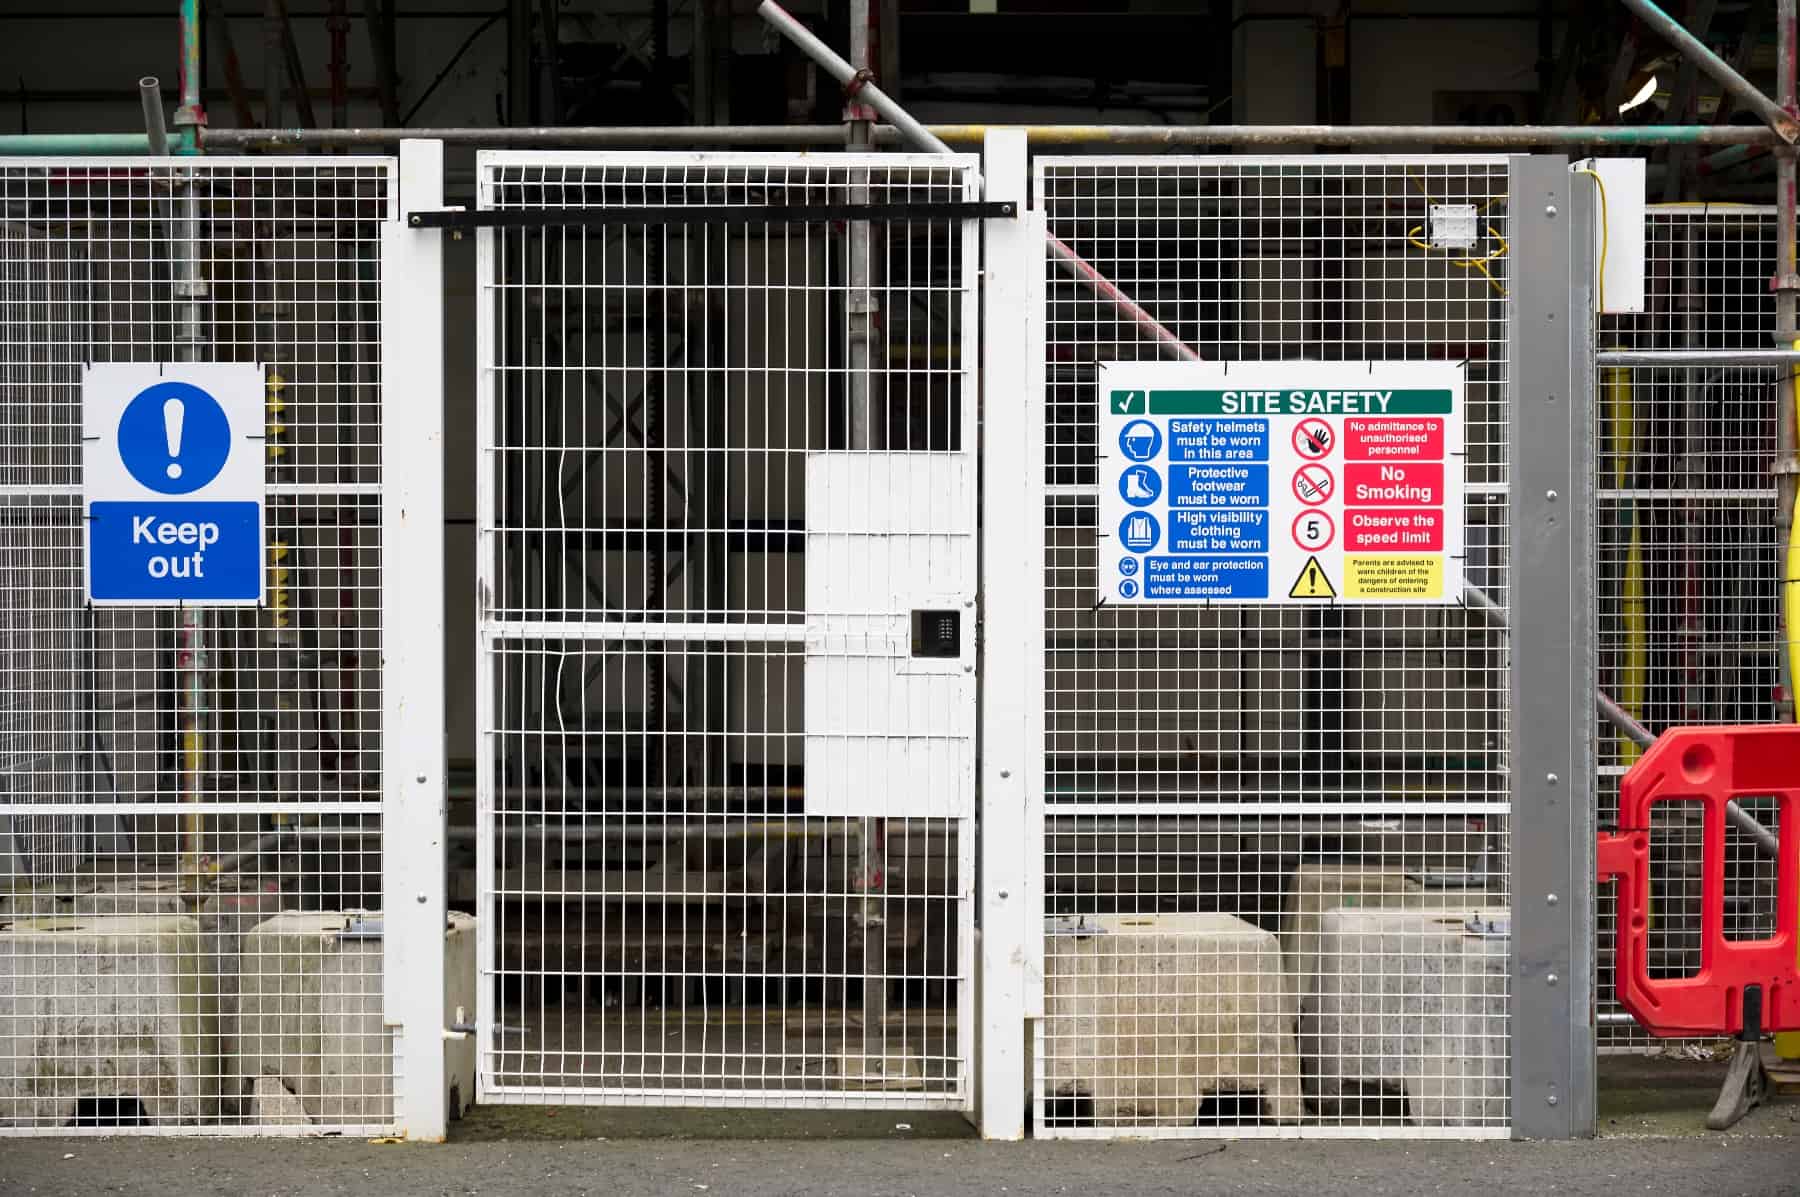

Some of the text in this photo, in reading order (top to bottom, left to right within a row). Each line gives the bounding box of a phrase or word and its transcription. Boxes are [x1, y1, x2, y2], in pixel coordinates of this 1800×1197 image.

[1222, 392, 1392, 413] SITE SAFETY
[1172, 422, 1264, 435] Safety helmets
[1351, 422, 1437, 431] No admittance to
[1177, 437, 1207, 445] must
[1211, 435, 1226, 445] be
[1360, 434, 1427, 443] unauthorised
[1184, 449, 1196, 458] in
[1199, 448, 1222, 458] this
[1368, 446, 1419, 456] personnel
[1189, 467, 1248, 478] Protective
[1381, 466, 1405, 480] No
[1192, 481, 1245, 491] footwear
[1356, 484, 1431, 501] Smoking
[1178, 494, 1259, 504] must be worn
[1178, 512, 1262, 523] High visibility
[1352, 516, 1434, 527] Observe the
[133, 515, 219, 551] Keep
[1191, 526, 1240, 537] clothing
[1307, 520, 1319, 539] 5
[1177, 540, 1207, 549] must
[1211, 538, 1226, 549] be
[1357, 532, 1430, 546] speed limit
[148, 552, 204, 577] out
[1150, 561, 1168, 571] Eye
[1172, 561, 1190, 569] and
[1212, 561, 1263, 571] protection
[1178, 573, 1190, 582] be
[1150, 586, 1232, 594] where assessed
